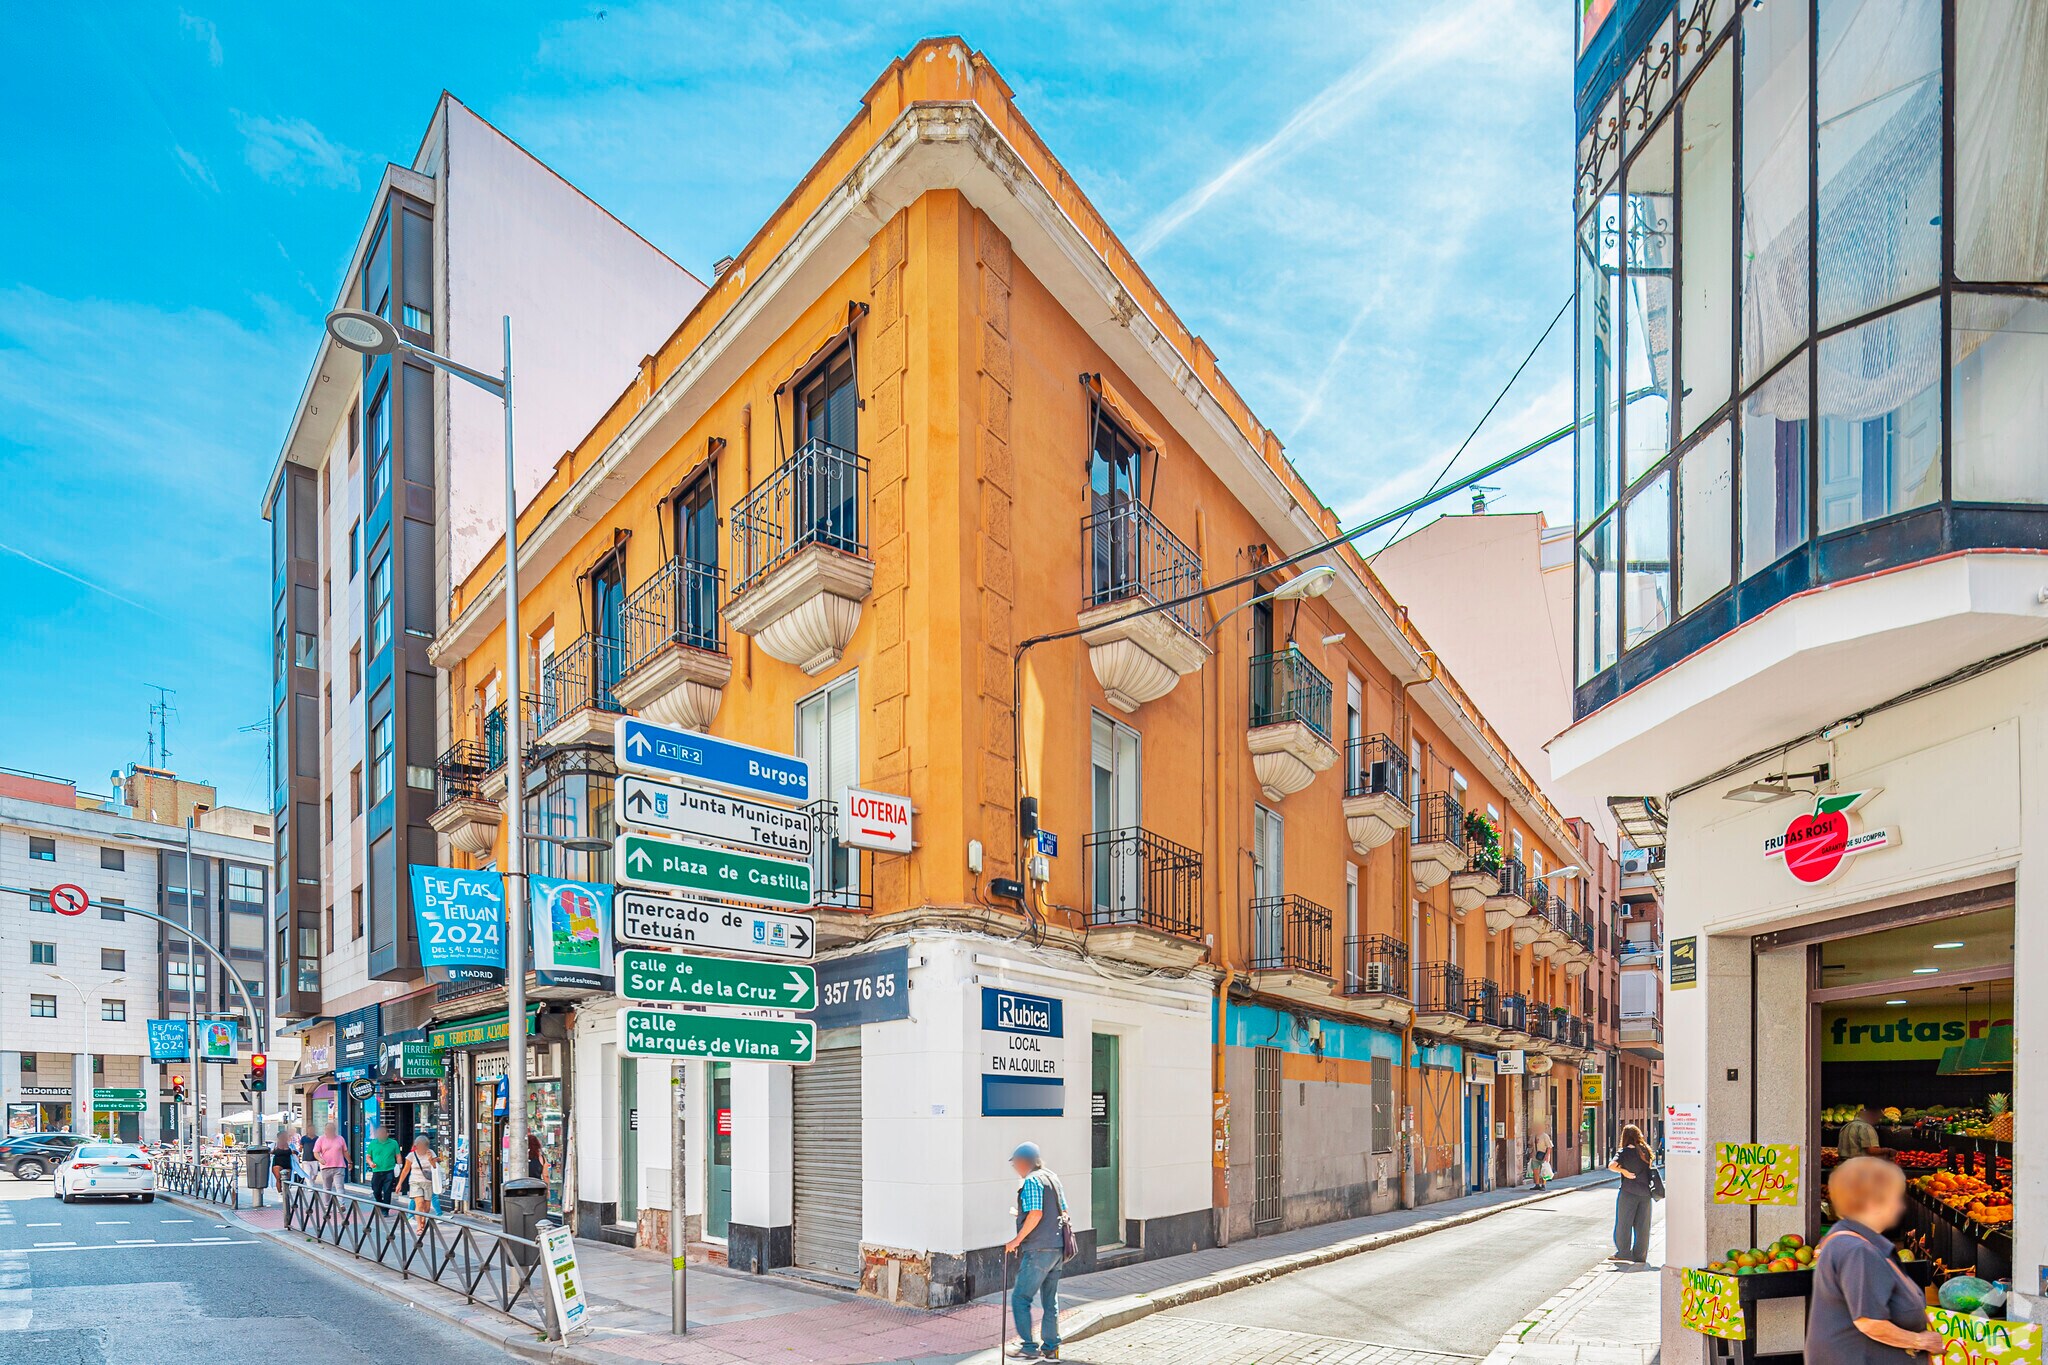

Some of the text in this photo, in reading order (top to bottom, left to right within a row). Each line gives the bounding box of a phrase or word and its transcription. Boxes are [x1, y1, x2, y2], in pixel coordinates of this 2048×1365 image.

[659, 743, 701, 762] A-1 R-2
[749, 760, 807, 787] Burgos
[680, 793, 808, 832] Junta Municipal
[850, 796, 908, 826] LOTERIA
[751, 826, 808, 851] Tetuán
[1765, 820, 1832, 850] FRUTAS ROSI
[1847, 839, 1853, 847] DE
[1854, 837, 1861, 845] SU
[1862, 830, 1886, 843] COMPRA
[663, 856, 809, 891] plaza de Castilla
[424, 876, 493, 900] FIESTAS
[628, 902, 743, 928] mercado de
[429, 922, 499, 945] 2024
[628, 918, 695, 941] Tetuán
[460, 970, 493, 978] MADRID
[630, 960, 693, 974] calle de
[631, 974, 777, 1000] Sor A. de la Cruz
[824, 974, 895, 1006] 357 76 55
[628, 1015, 677, 1031] calle
[1000, 996, 1048, 1028] Rubica
[154, 1041, 184, 1050] 2024
[628, 1032, 779, 1055] Marqués de Viana
[1009, 1036, 1041, 1052] LOCAL
[407, 1058, 441, 1066] MATERIAL
[407, 1068, 441, 1076] ELECTRICO
[992, 1056, 1055, 1073] EN ALQUILER
[21, 1087, 71, 1095] McDonald's
[1726, 1144, 1777, 1165] MANGO
[1716, 1163, 1743, 1196] 2
[1688, 1269, 1722, 1295] MANGO
[1683, 1288, 1697, 1321] 2
